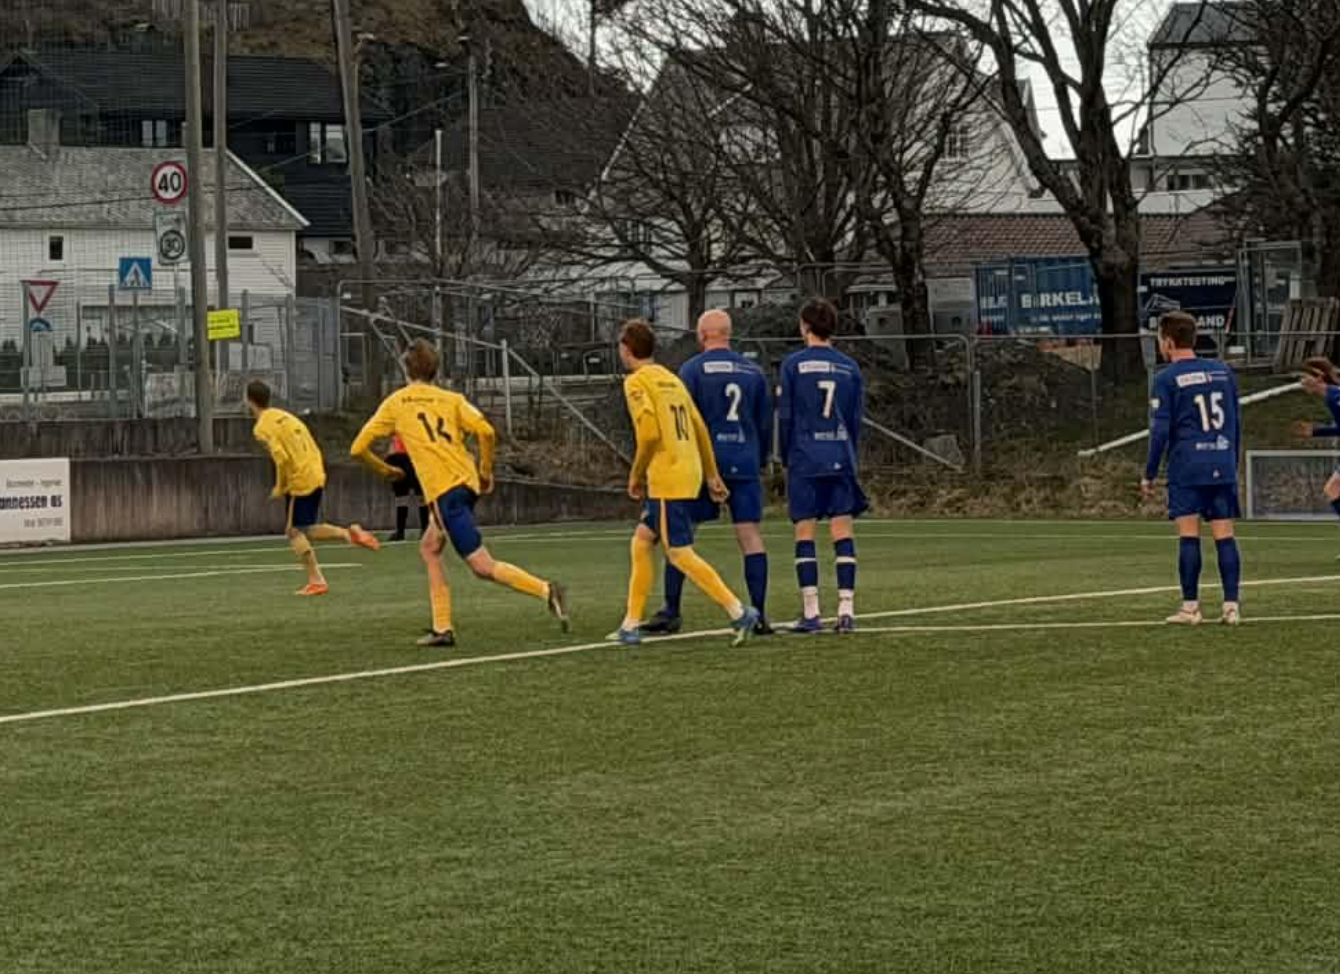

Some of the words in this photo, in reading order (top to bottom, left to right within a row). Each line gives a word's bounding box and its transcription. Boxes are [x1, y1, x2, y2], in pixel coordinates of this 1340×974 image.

[158, 171, 182, 193] 40
[724, 382, 742, 422] 2
[817, 380, 837, 419] 7
[1193, 391, 1226, 432] 15
[670, 404, 690, 442] 10
